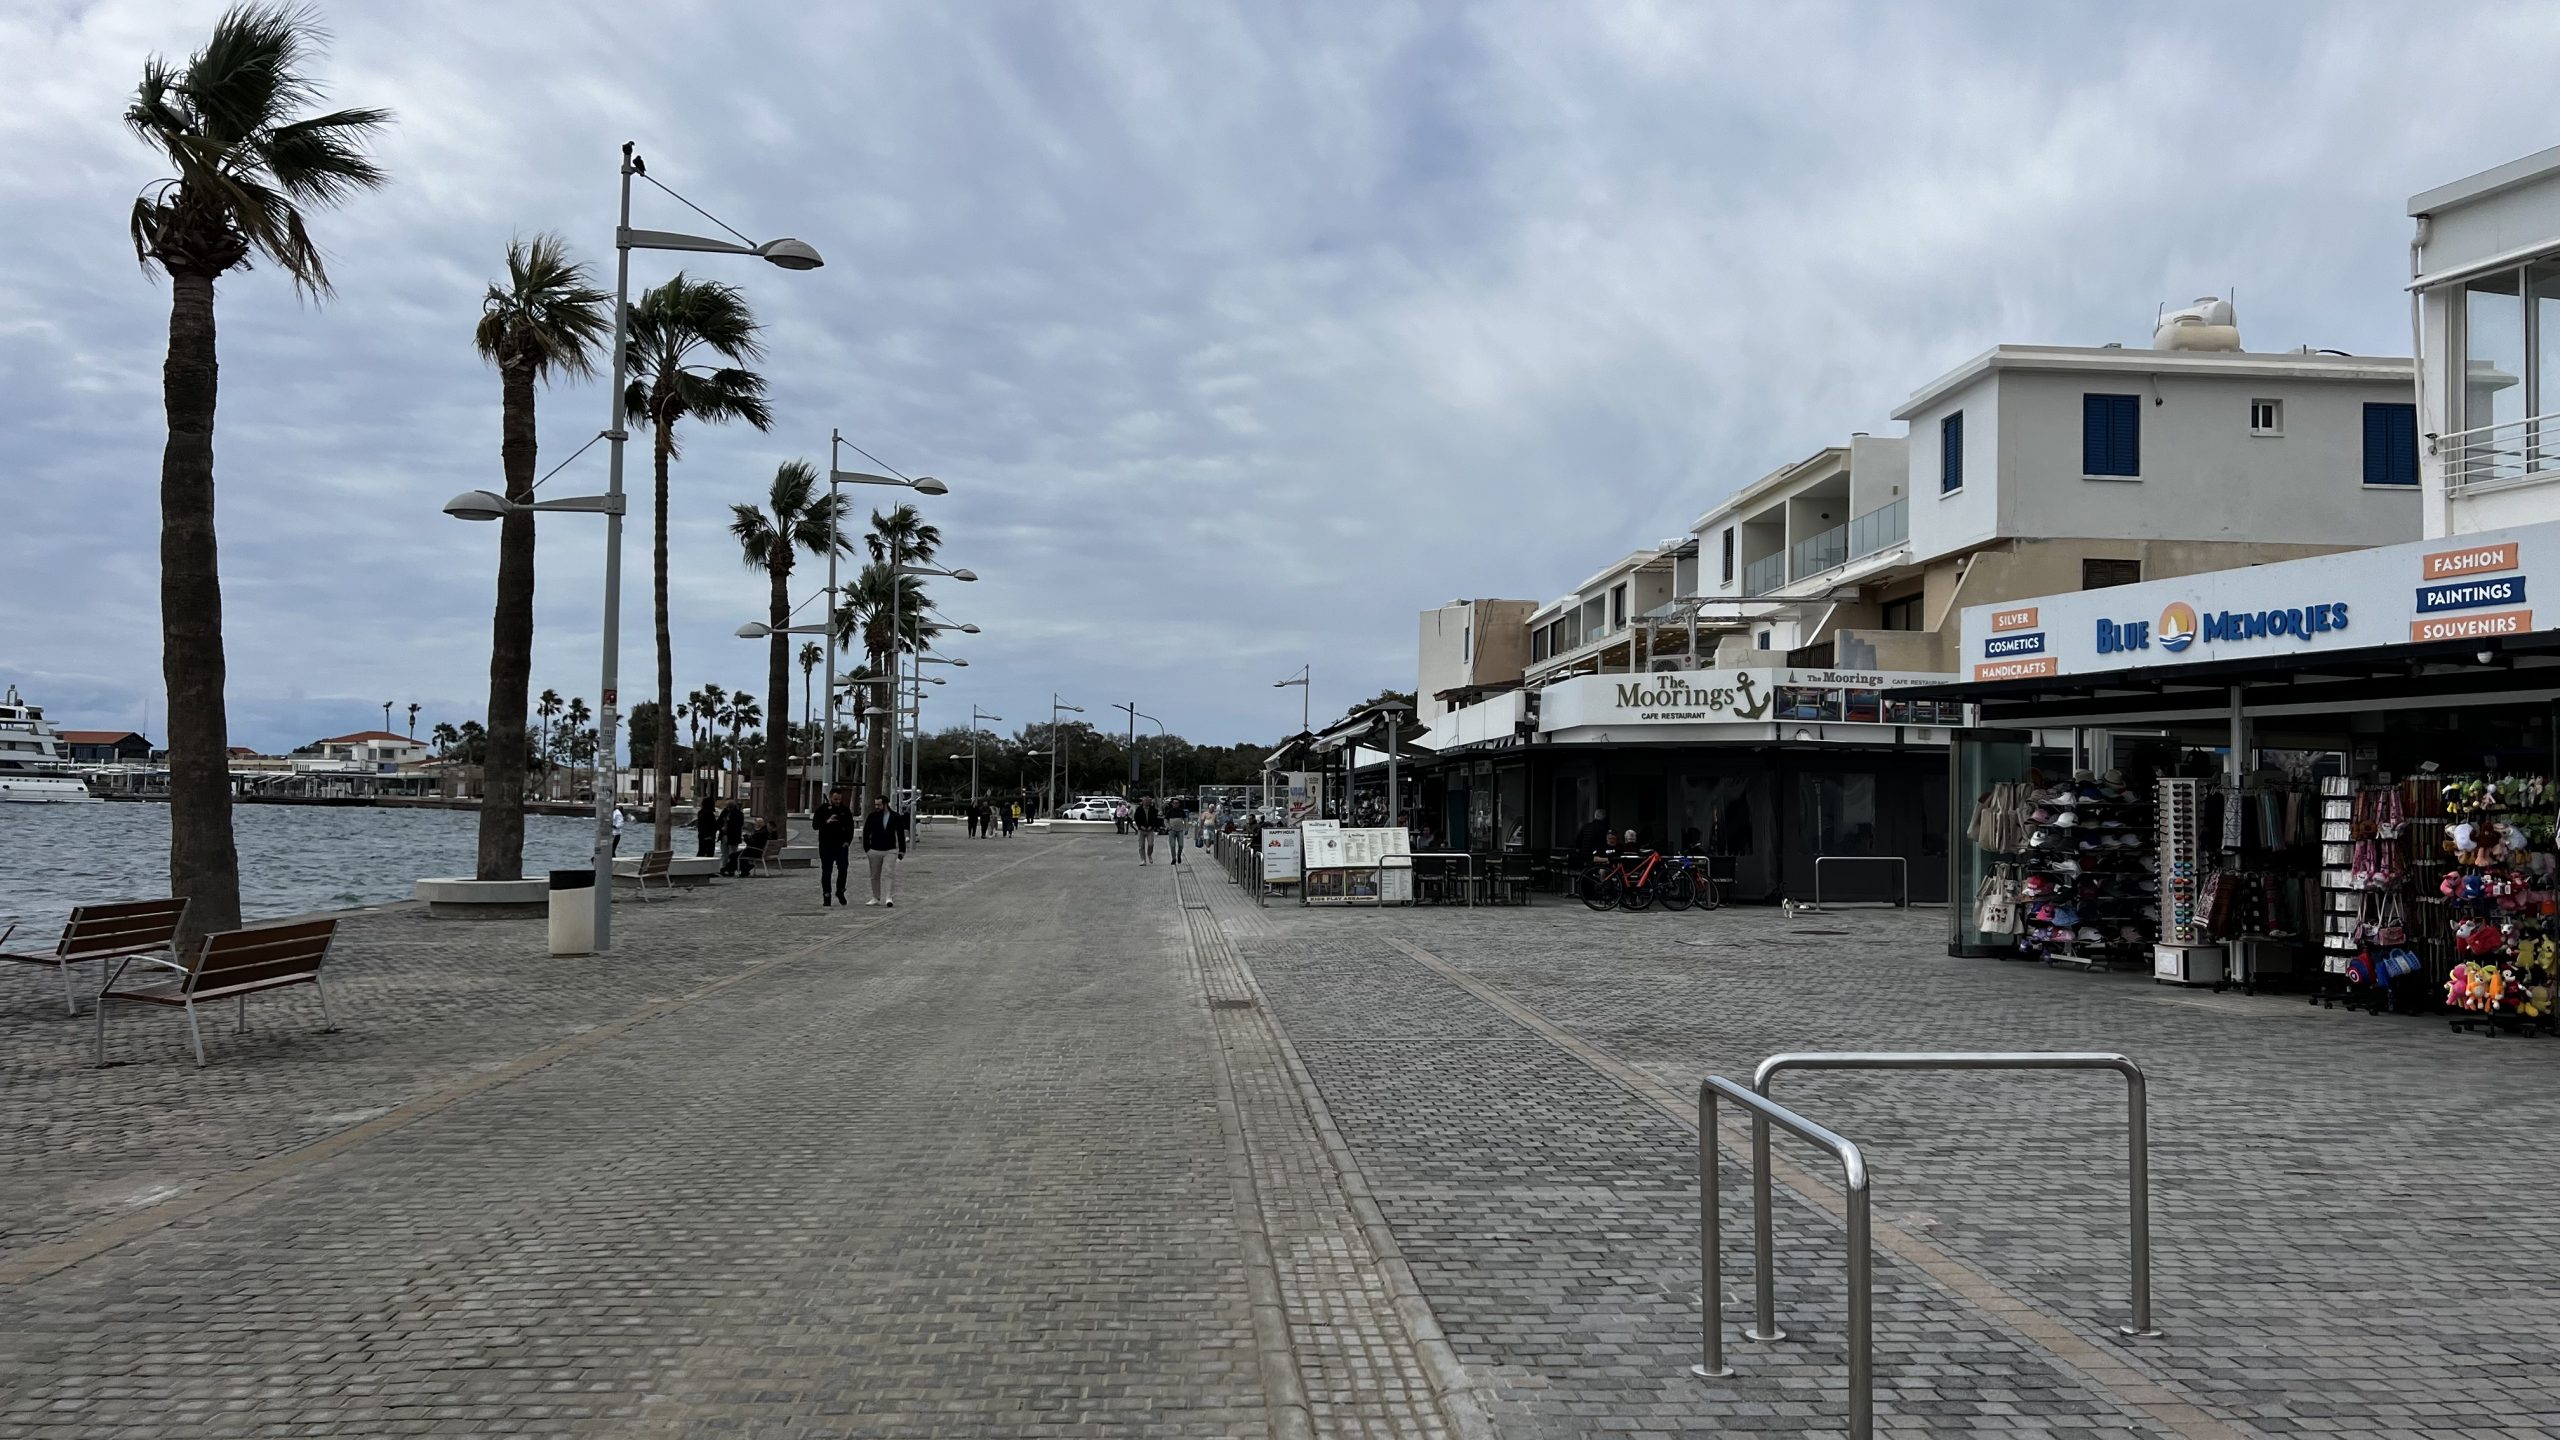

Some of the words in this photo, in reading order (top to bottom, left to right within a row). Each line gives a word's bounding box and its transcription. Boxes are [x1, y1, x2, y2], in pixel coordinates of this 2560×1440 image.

[2434, 550, 2504, 572] FASHION
[2427, 583, 2512, 606] PAINTINGS
[1998, 613, 2029, 627] SILVER
[2096, 618, 2150, 654] BLUE
[2203, 602, 2349, 643] MEMORIES
[2423, 616, 2517, 639] SOUVENIRS
[1988, 637, 2040, 653] COSMETICS
[1982, 662, 2046, 678] HANDICRAFTS
[1657, 676, 1686, 689] The
[1807, 674, 1822, 682] The
[1823, 672, 1884, 686] Moorings
[1616, 683, 1735, 711] Moorings
[1661, 712, 1706, 720] RESTAURANT
